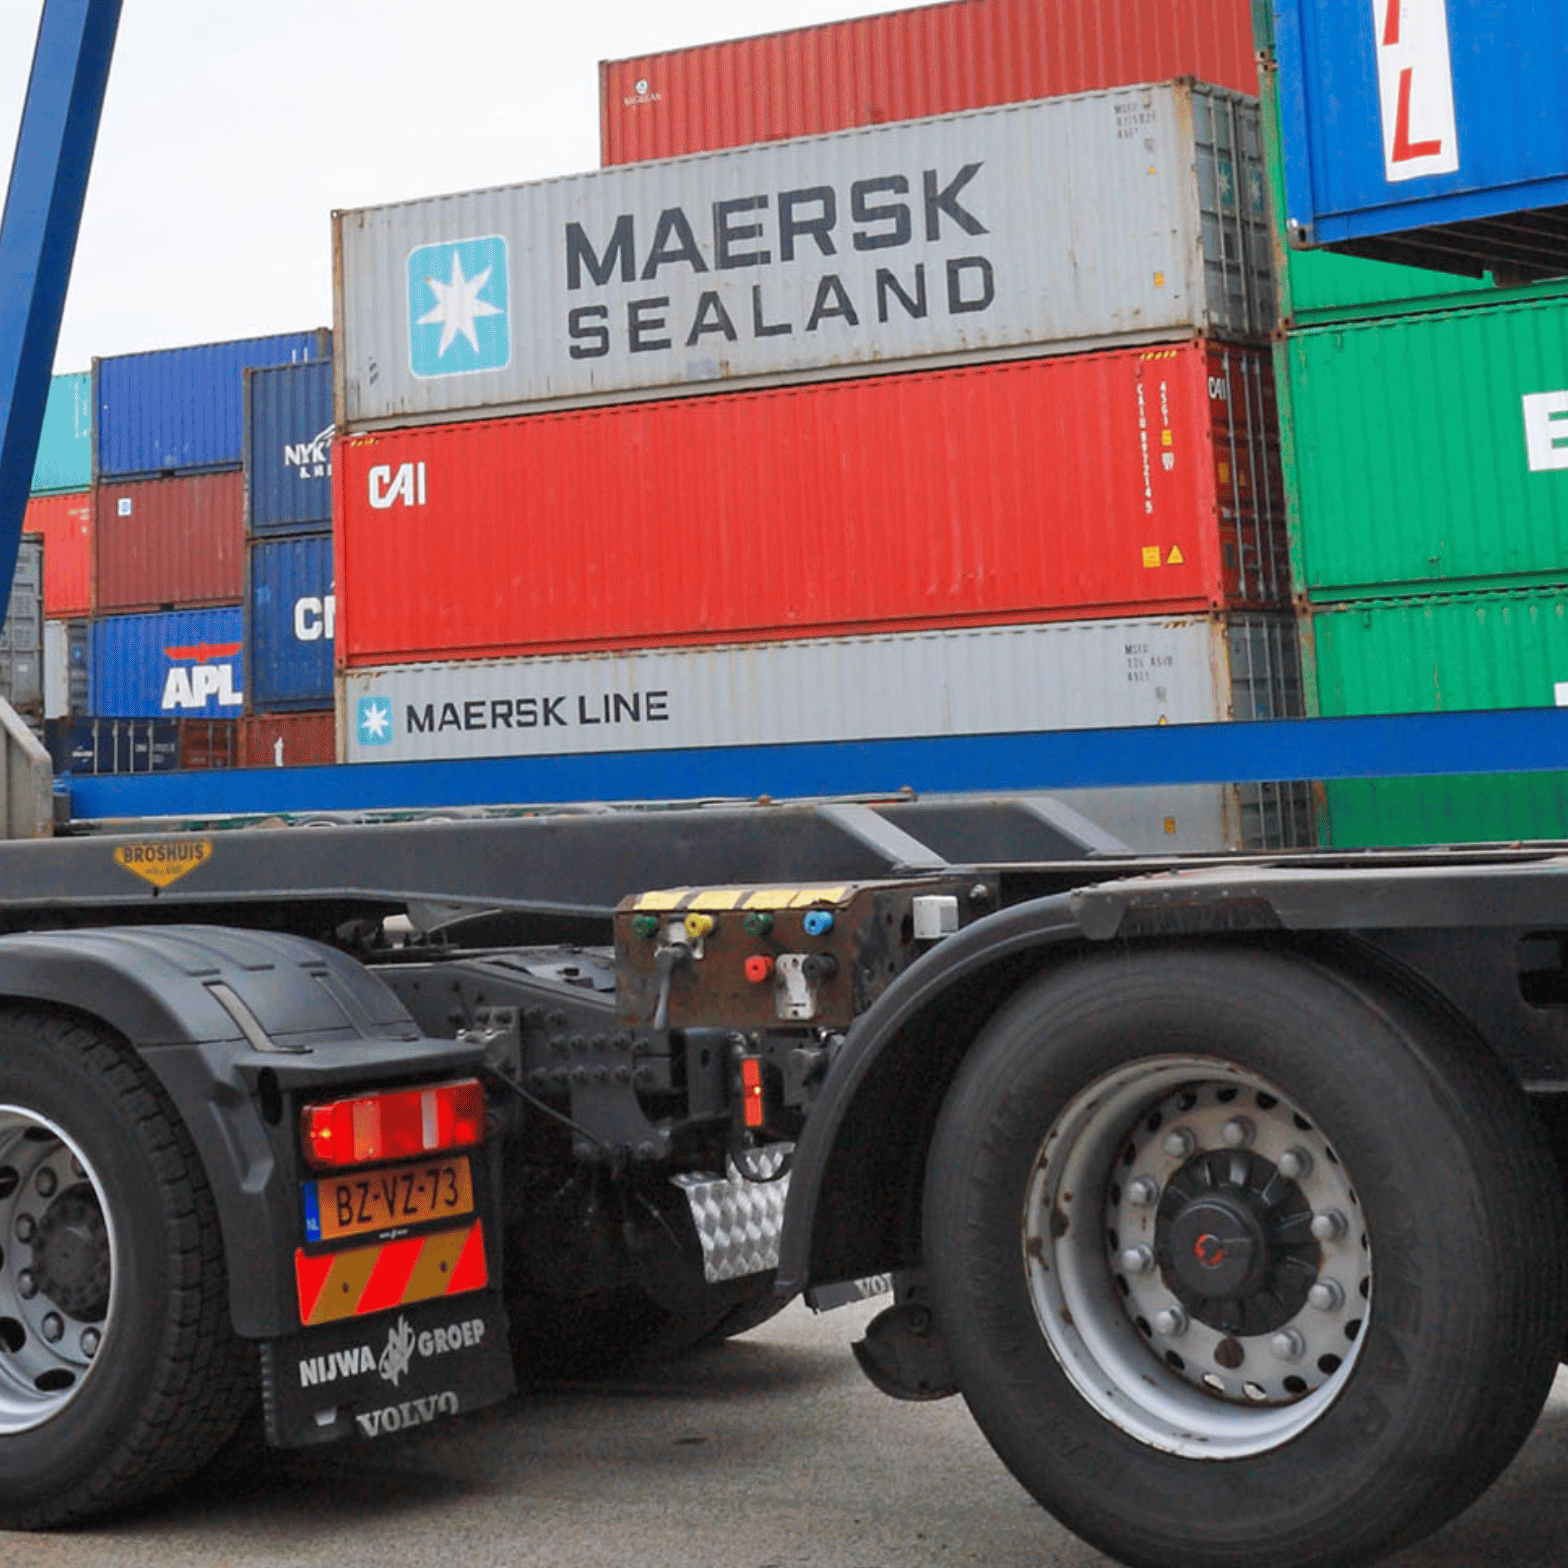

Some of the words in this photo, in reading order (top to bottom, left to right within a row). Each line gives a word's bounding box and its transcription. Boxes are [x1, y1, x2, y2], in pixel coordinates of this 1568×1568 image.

[564, 161, 990, 290] MAERSK
[568, 255, 996, 361] SEALAND
[284, 443, 326, 466] NYK
[368, 461, 427, 509] CAI
[161, 664, 243, 710] APL
[406, 696, 566, 734] MAERSK
[577, 690, 669, 725] LINE
[123, 842, 204, 863] BROSHUIS
[335, 1166, 460, 1228] BZ-VZ-73
[299, 1345, 377, 1387] NIJWA
[417, 1318, 485, 1357] GROEP
[355, 1391, 460, 1437] VOLVO
